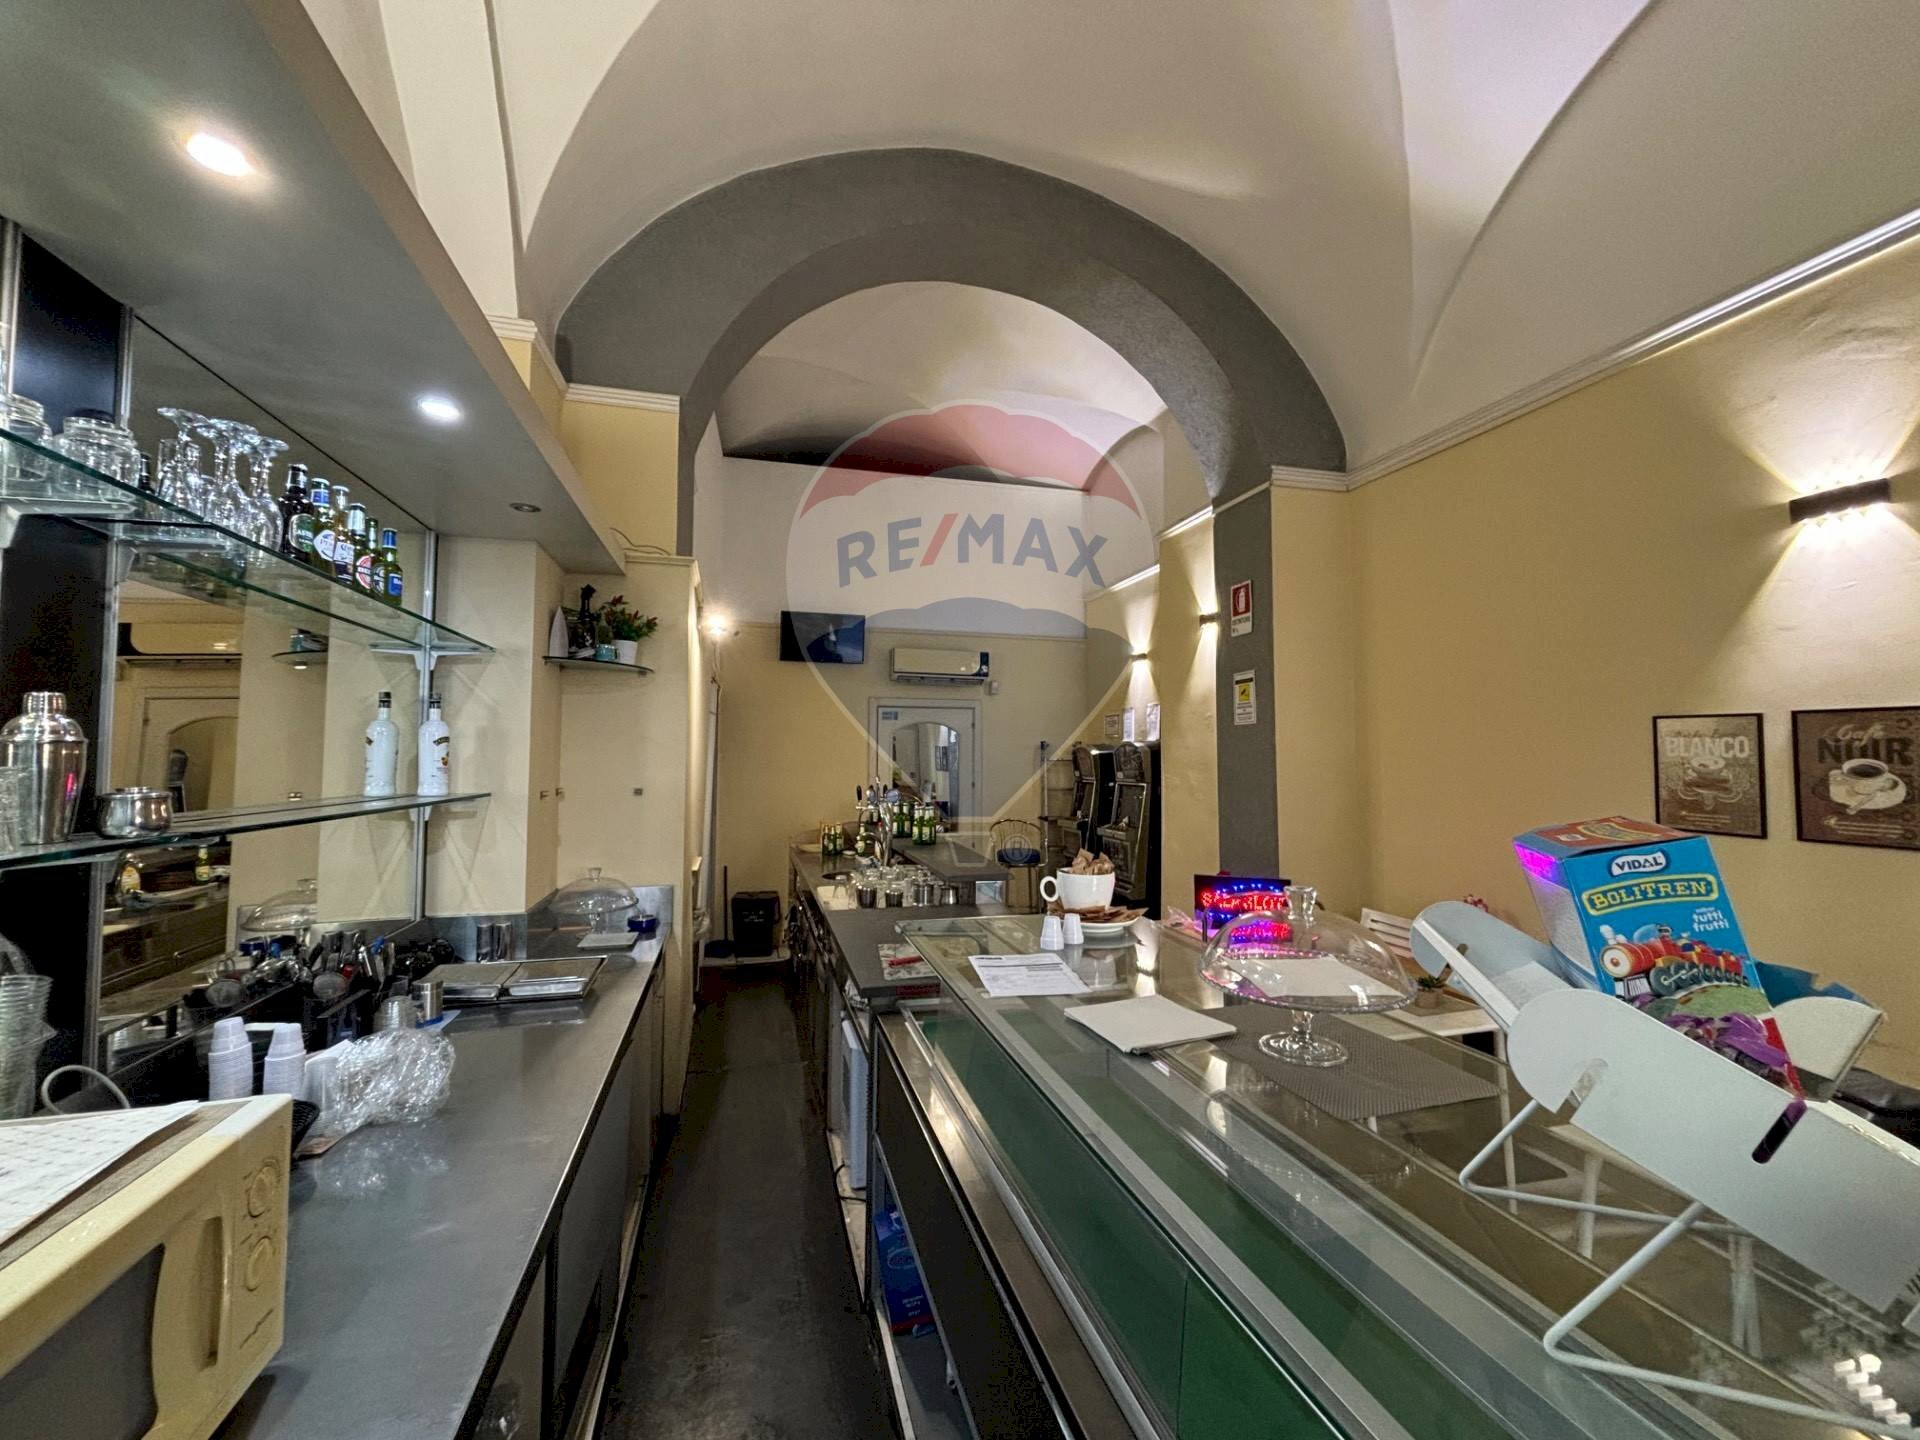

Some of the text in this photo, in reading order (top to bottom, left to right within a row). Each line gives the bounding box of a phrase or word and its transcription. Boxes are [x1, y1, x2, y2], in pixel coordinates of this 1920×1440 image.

[1664, 735, 1750, 758] BLANCO
[1615, 856, 1663, 871] VIDAL
[1591, 881, 1708, 909] BOLITREN
[1692, 909, 1723, 923] tutti
[1692, 918, 1730, 933] frutti
